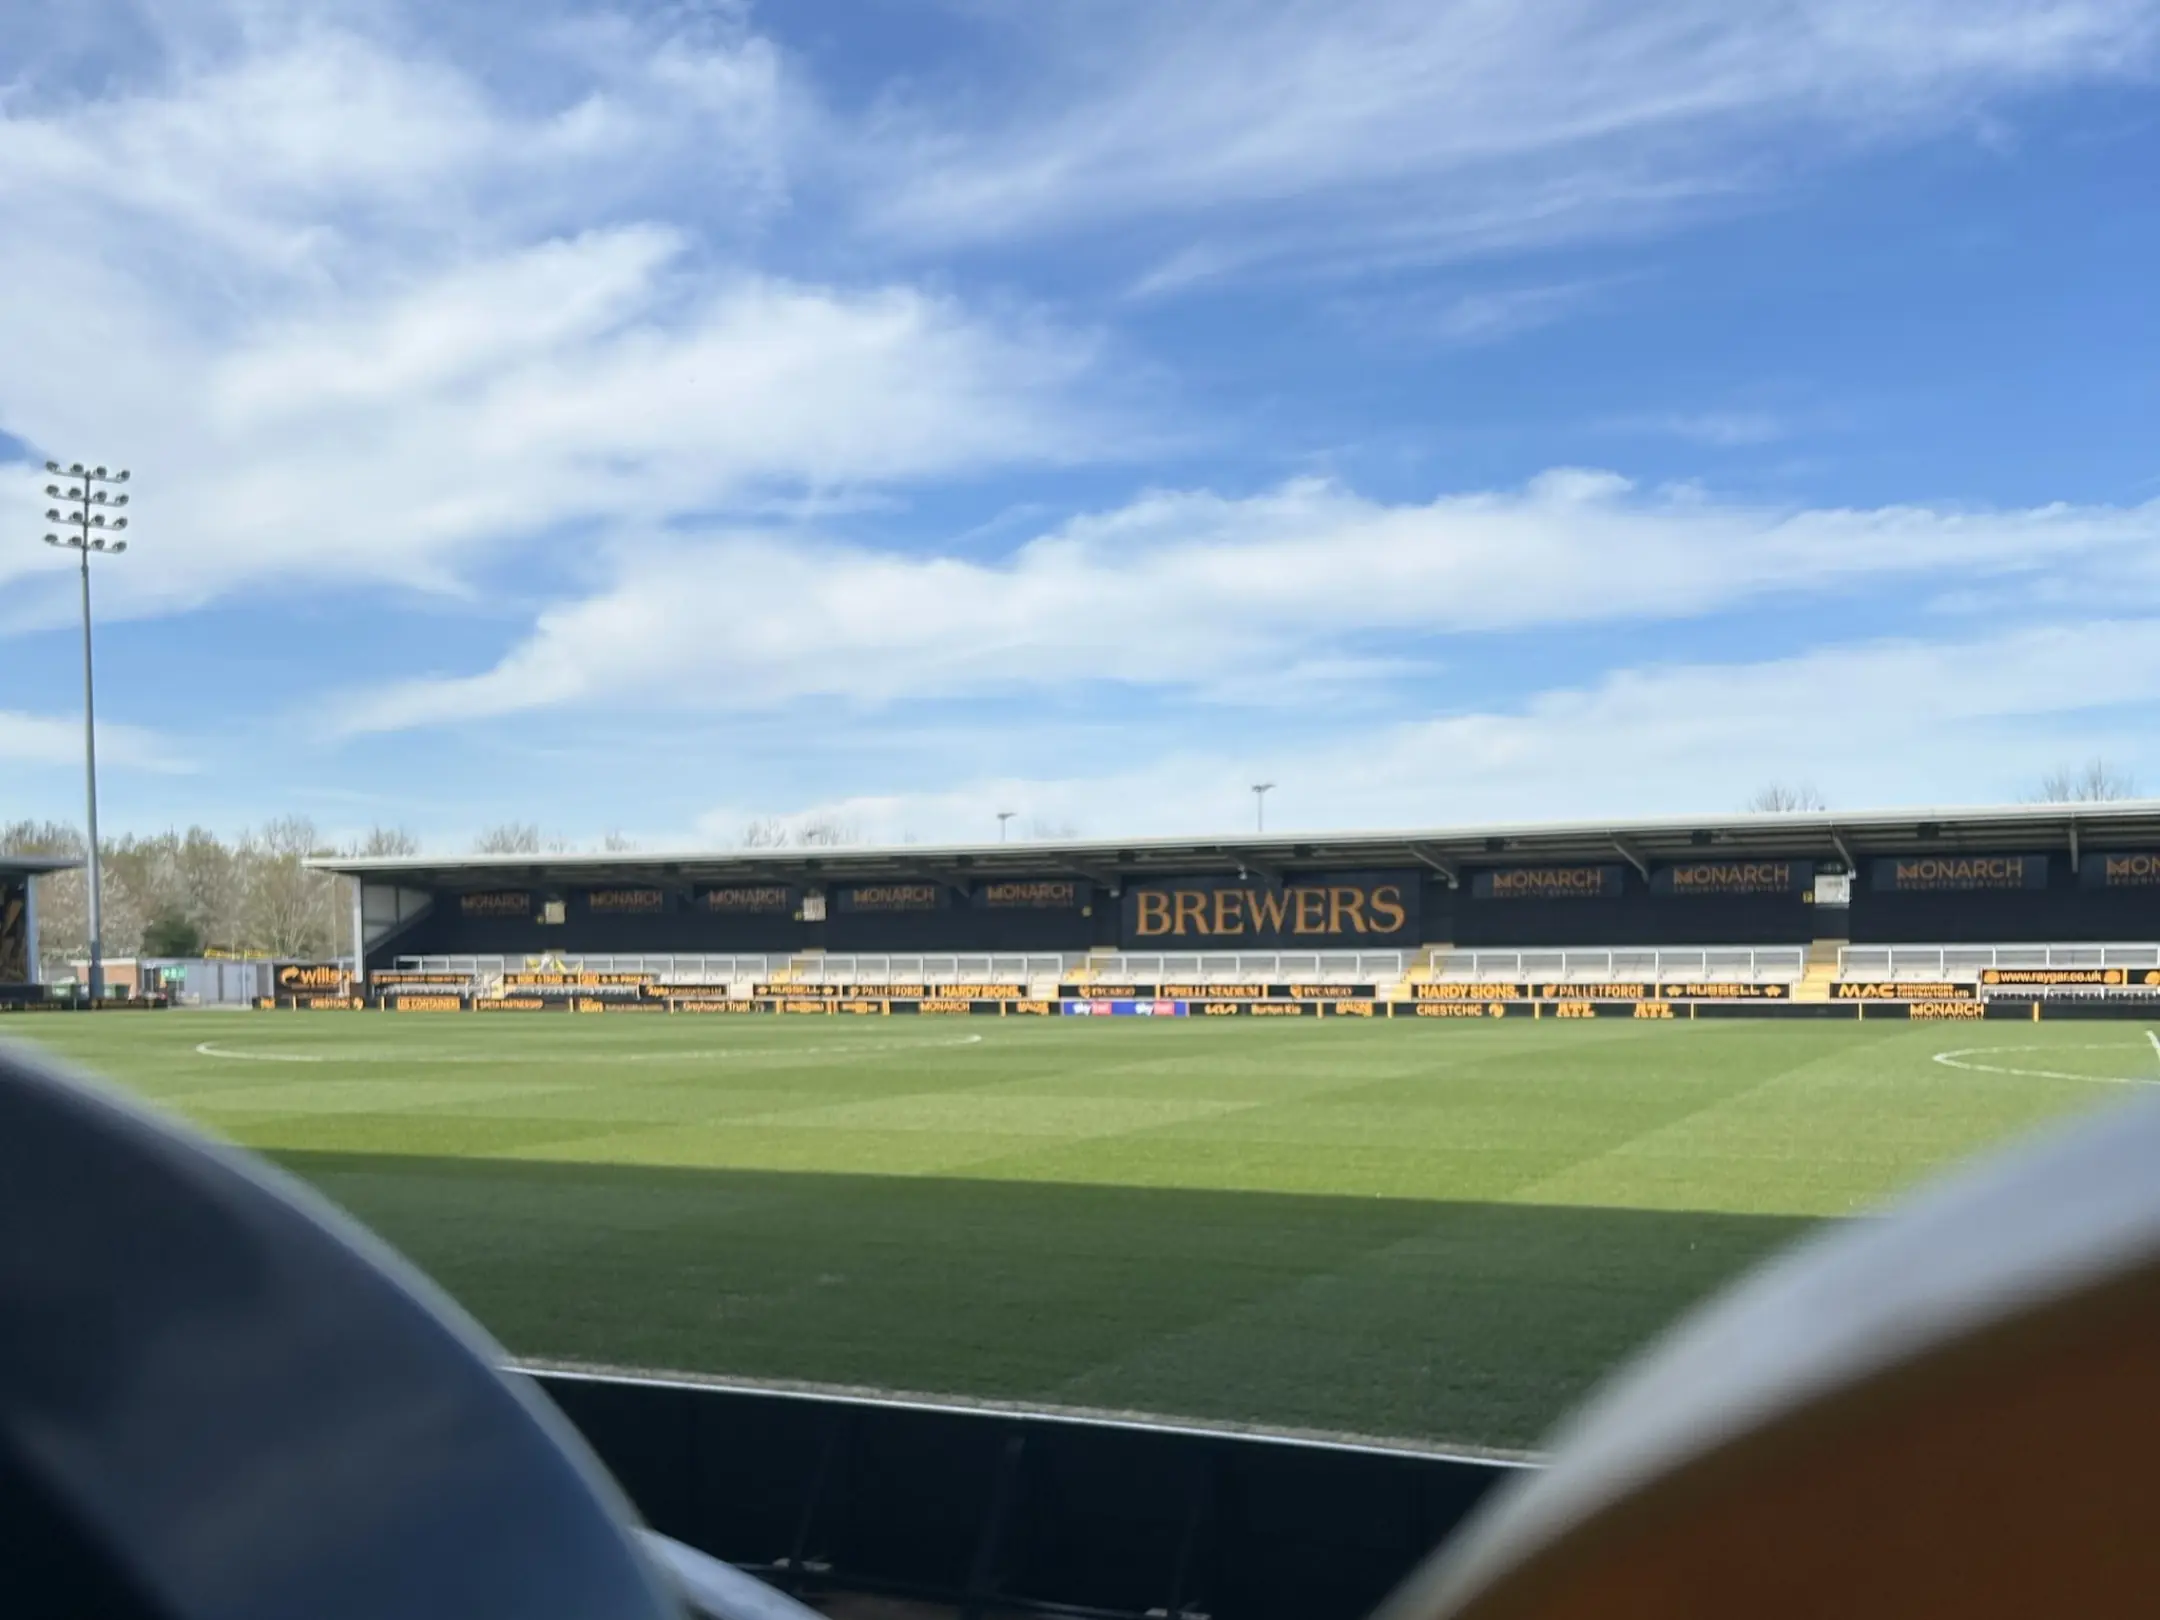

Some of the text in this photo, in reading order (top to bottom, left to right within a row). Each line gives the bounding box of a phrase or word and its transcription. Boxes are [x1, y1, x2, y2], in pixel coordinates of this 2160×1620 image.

[1674, 864, 1789, 884] MONARCH
[1897, 856, 2022, 878] MONARCH
[1493, 869, 1601, 888] MONARCH
[590, 891, 663, 907] MONARCH
[710, 888, 786, 905] MONARCH
[854, 885, 935, 904] MONARCH
[988, 884, 1073, 901] MONARCH
[1136, 886, 1405, 935] BREWERS
[1418, 984, 1467, 998] HARDY
[1559, 985, 1644, 998] PALLETFORCE
[1838, 983, 1894, 998] MAC
[1416, 1003, 1482, 1016] CRESTCHIC
[1911, 1003, 1984, 1016] MONARCH
